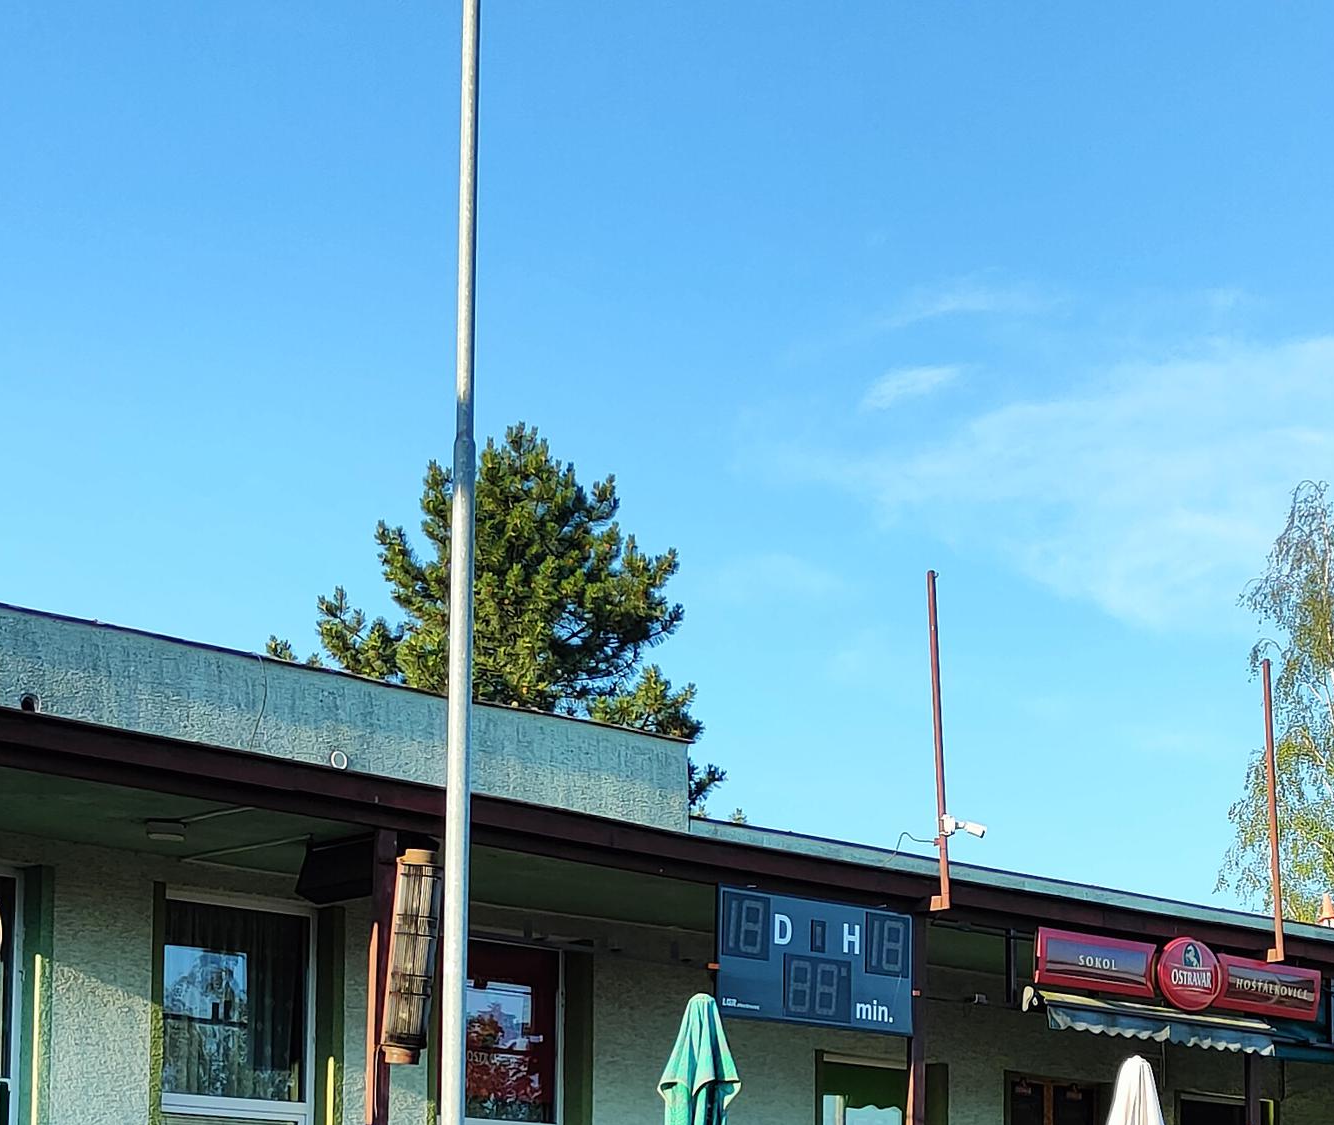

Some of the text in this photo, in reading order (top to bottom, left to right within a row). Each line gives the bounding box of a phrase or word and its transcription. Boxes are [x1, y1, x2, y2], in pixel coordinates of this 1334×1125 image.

[773, 913, 793, 946] D
[842, 922, 861, 955] H
[1077, 953, 1118, 971] SOKOL
[1171, 968, 1212, 988] OSTRAVAR
[855, 999, 894, 1023] min.
